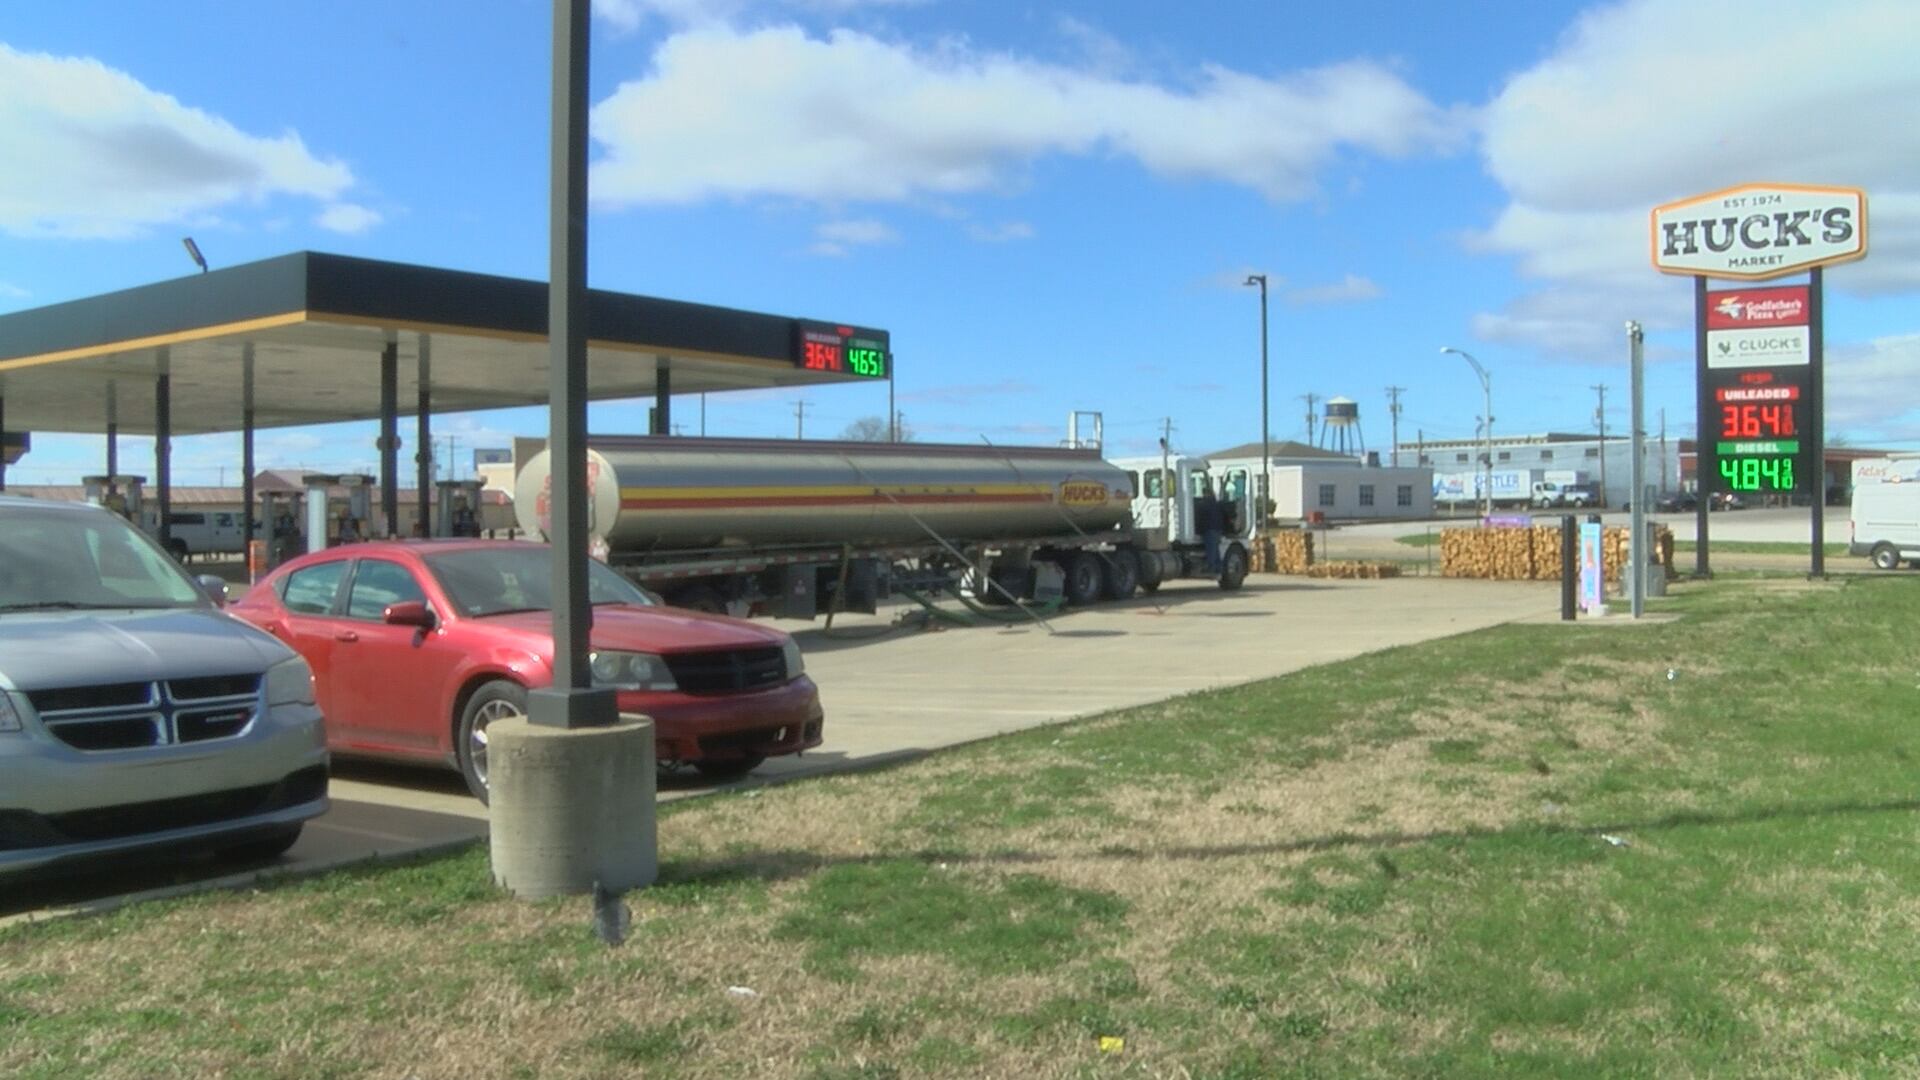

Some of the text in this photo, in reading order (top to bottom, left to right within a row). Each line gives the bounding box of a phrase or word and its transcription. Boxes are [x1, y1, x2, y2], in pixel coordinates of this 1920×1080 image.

[1723, 195, 1782, 208] EST 1974
[1663, 207, 1853, 256] HUCK'S
[1728, 254, 1784, 268] MARKET
[1724, 388, 1791, 401] UNLEADED
[1735, 442, 1779, 453] DIESEL
